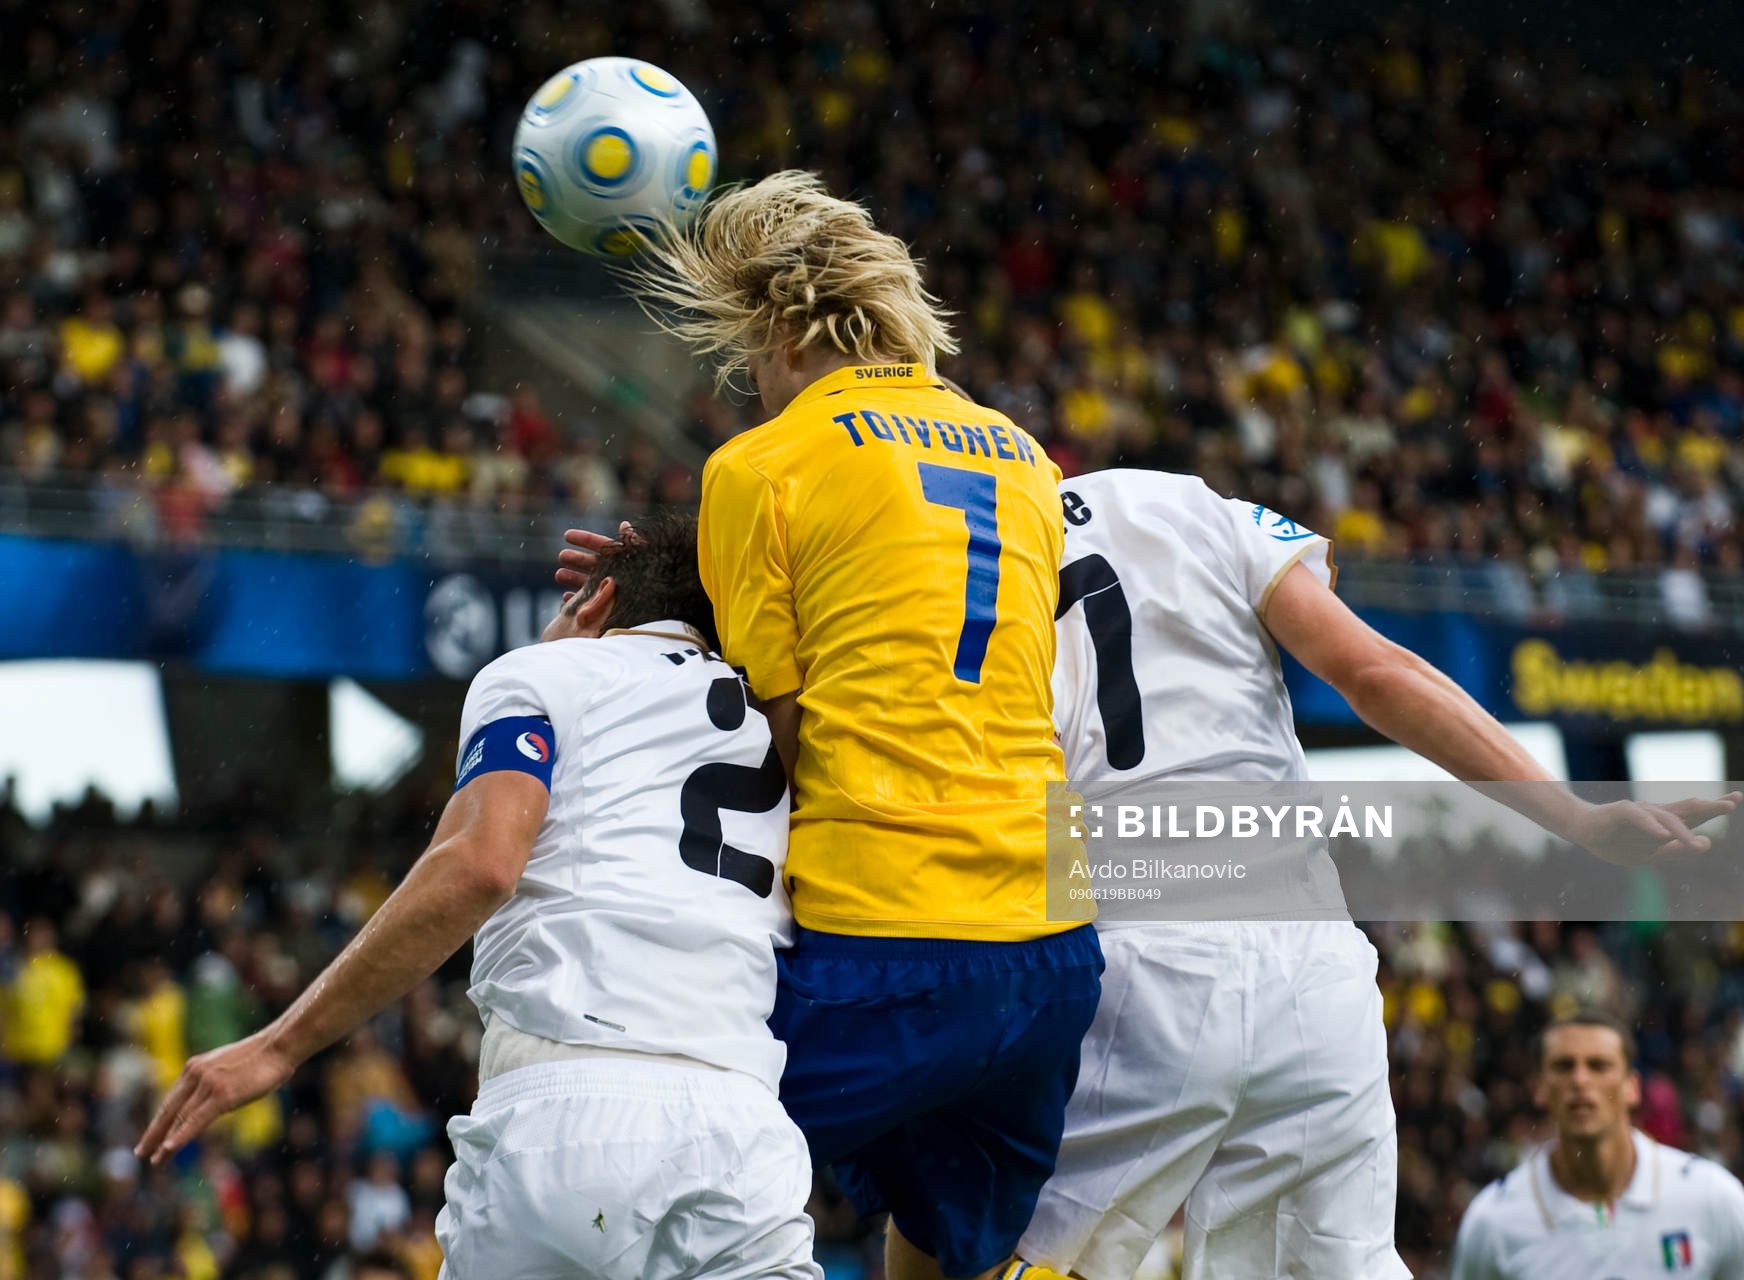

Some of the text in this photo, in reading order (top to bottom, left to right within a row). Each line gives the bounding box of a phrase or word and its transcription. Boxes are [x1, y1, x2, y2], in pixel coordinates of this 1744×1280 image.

[855, 366, 913, 379] SVERIGE
[833, 410, 1036, 468] TOIVONEN
[917, 462, 1002, 684] 7
[1512, 640, 1744, 721] Sweden
[679, 677, 788, 898] 2
